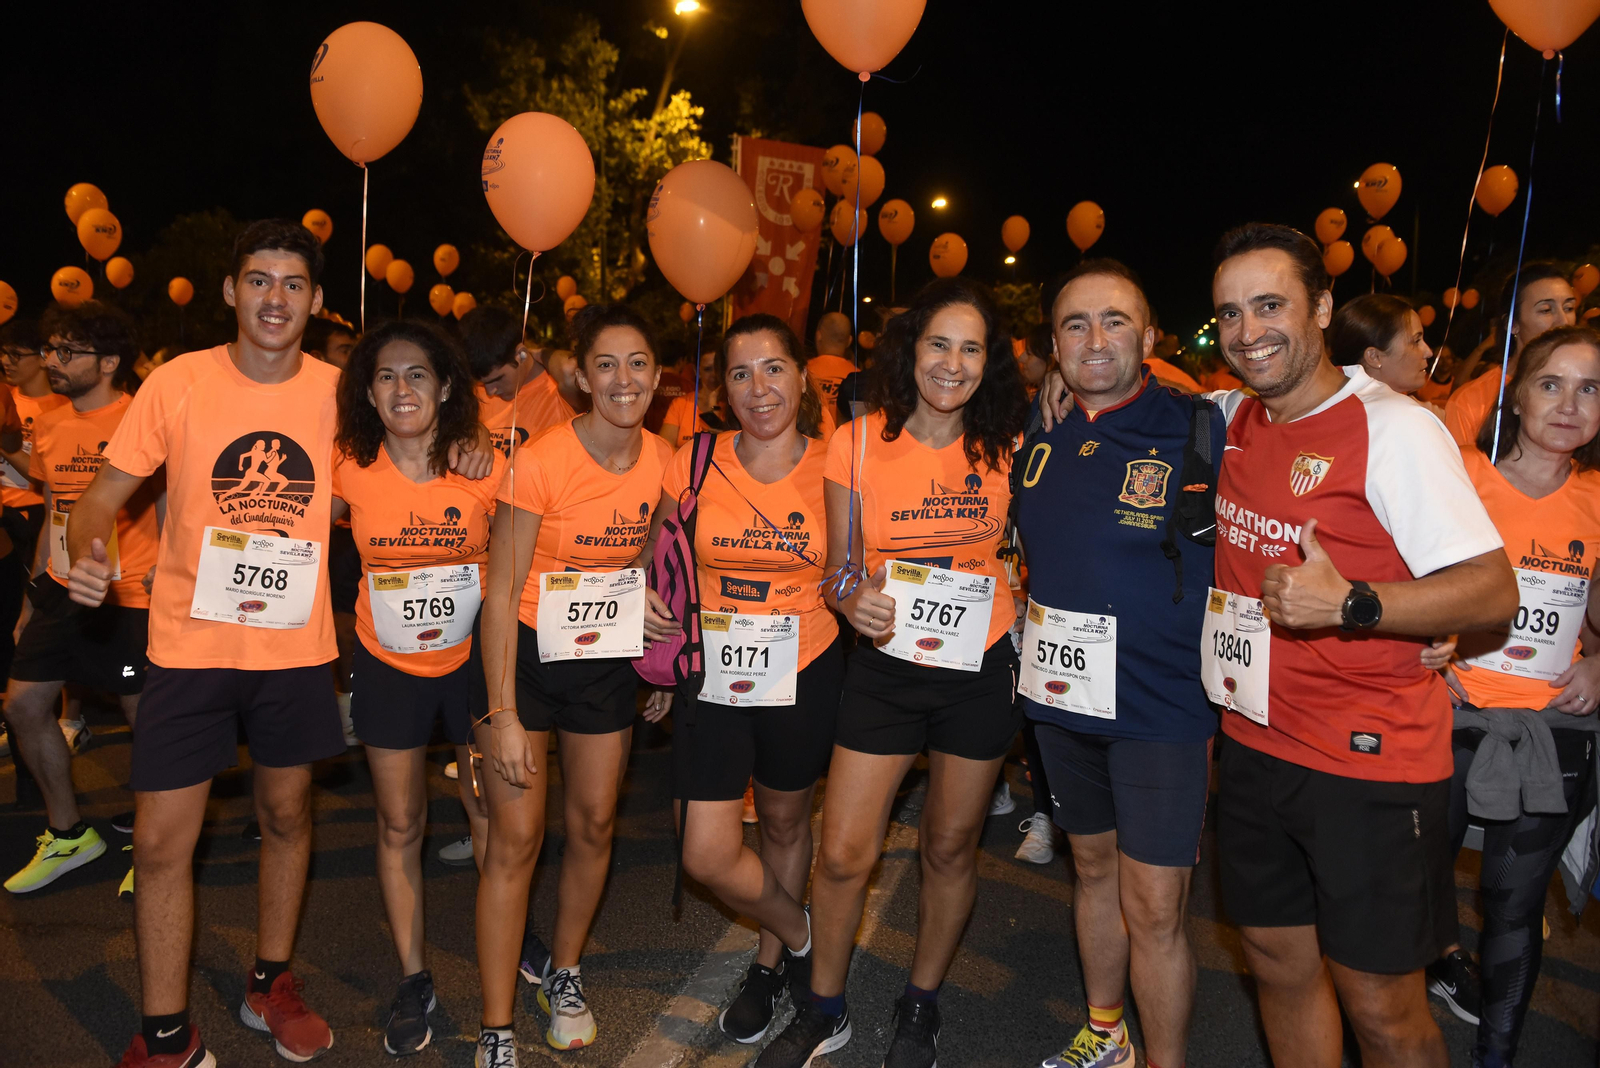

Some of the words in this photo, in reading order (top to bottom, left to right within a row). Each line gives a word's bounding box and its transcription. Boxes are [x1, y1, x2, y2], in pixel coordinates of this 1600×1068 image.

[922, 496, 989, 506] NOCTURNA
[219, 503, 237, 515] LA
[239, 499, 305, 518] NOCTURNA
[891, 508, 954, 522] SEVILLA
[230, 514, 243, 526] del
[1118, 520, 1157, 530] JOHANNESBURG
[1215, 493, 1302, 545] MARATHON
[400, 528, 468, 536] NOCTURNA
[604, 524, 649, 536] NOCTURNA
[743, 529, 810, 540] NOCTURNA
[369, 537, 430, 546] SEVILLA
[574, 535, 628, 547] SEVILLA
[712, 537, 772, 550] SEVILLA
[1229, 525, 1259, 553] BET
[1520, 556, 1590, 577] NOCTURNA
[233, 563, 289, 591] 5768
[403, 597, 455, 620] 5769
[567, 600, 618, 622] 5770
[910, 598, 967, 628] 5767
[920, 625, 939, 634] MORENO
[940, 630, 960, 638] ALVAREZ
[1213, 629, 1252, 668] 13840
[1534, 638, 1556, 646] BARRERA
[721, 645, 769, 668] 6171
[1037, 640, 1086, 671] 5766
